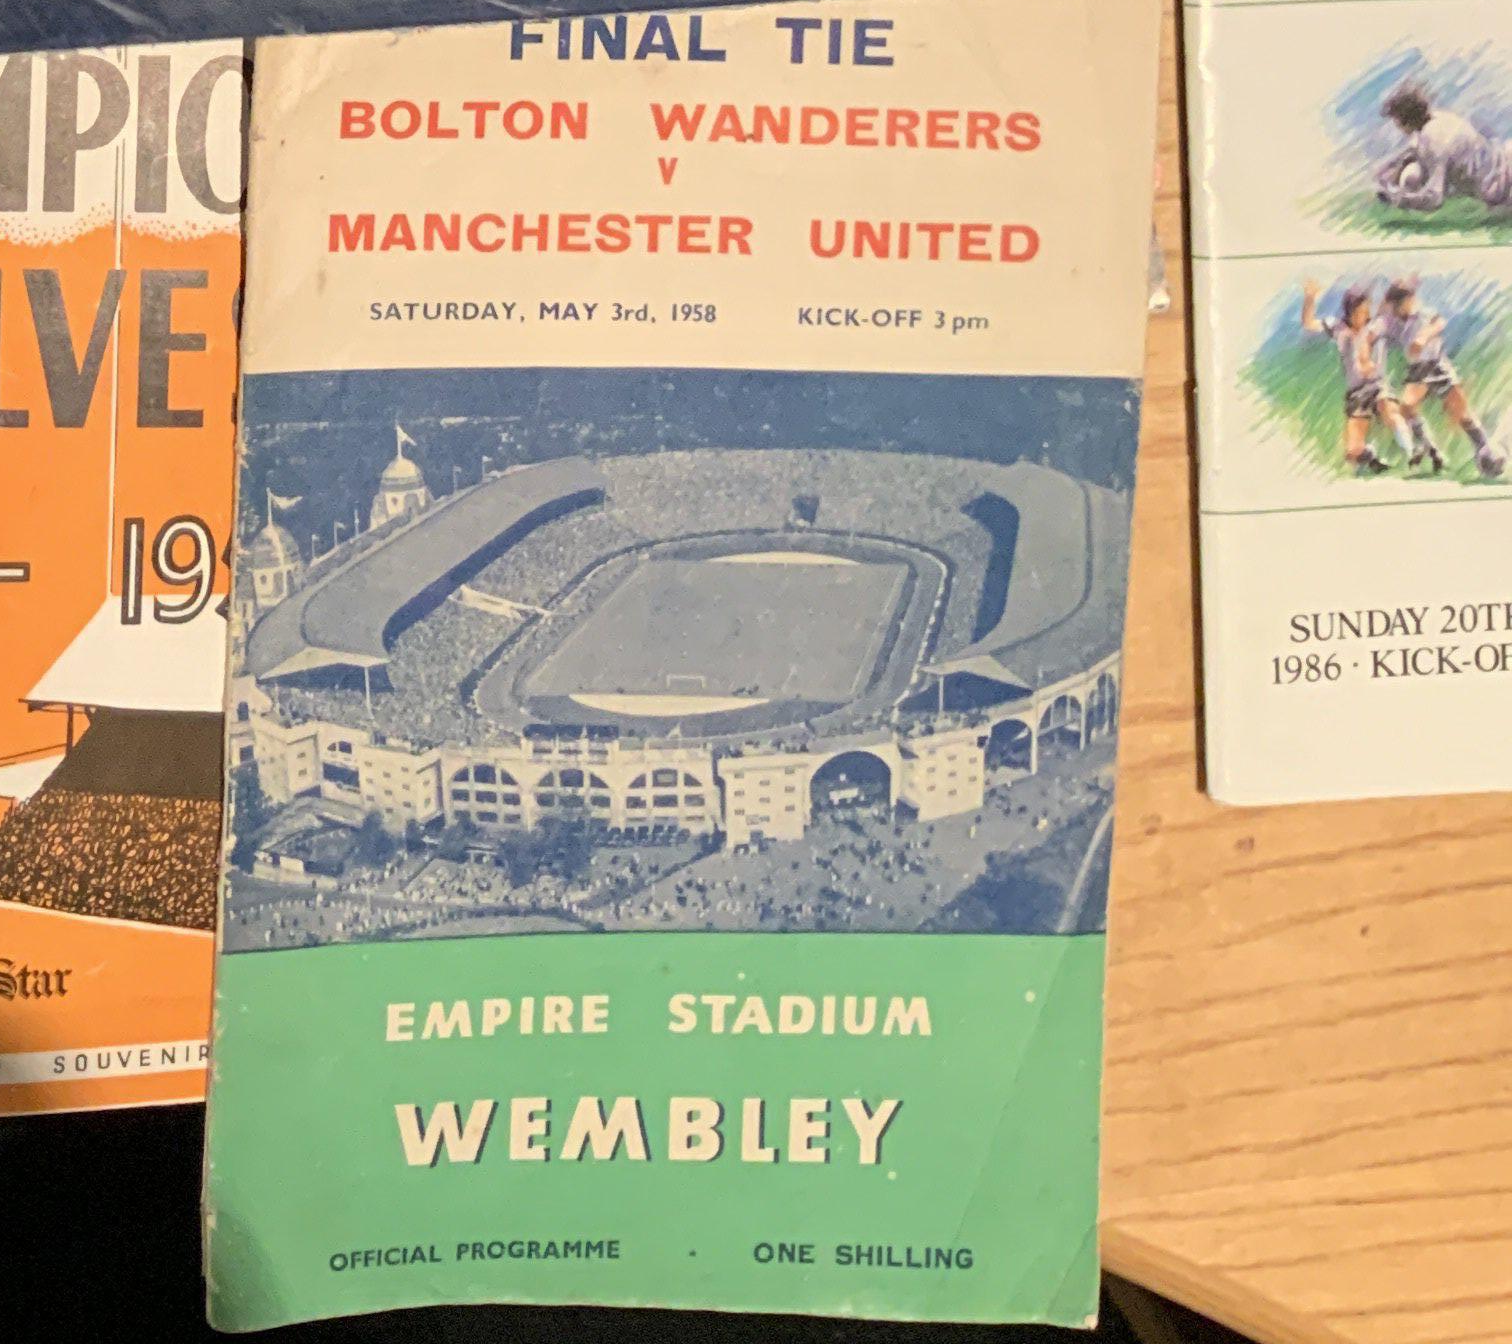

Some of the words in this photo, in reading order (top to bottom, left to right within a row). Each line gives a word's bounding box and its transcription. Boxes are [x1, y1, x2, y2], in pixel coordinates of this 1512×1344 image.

[509, 15, 728, 64] FINAL
[776, 18, 894, 66] TIE
[340, 100, 588, 140] BOLTON
[651, 103, 1041, 152] WANDERERS
[329, 213, 753, 255] MANCHESTER
[810, 219, 1040, 263] UNITED
[370, 302, 525, 322] SATURDAY,
[539, 302, 598, 321] MAY
[612, 303, 656, 323] 3rd,
[672, 303, 716, 323] 1958
[799, 308, 922, 328] KICK-OFF
[934, 311, 945, 329] 3
[1290, 607, 1430, 643] SUNDAY
[1272, 653, 1342, 685] 1986
[384, 994, 610, 1041] EMPIRE
[667, 993, 932, 1037] STADIUM
[394, 1094, 904, 1168] WEMBLEY
[328, 1243, 441, 1273] OFFICIAL
[456, 1237, 621, 1263] PROGRAMME
[752, 1241, 815, 1266] ONE
[834, 1243, 974, 1271] SHILLING
